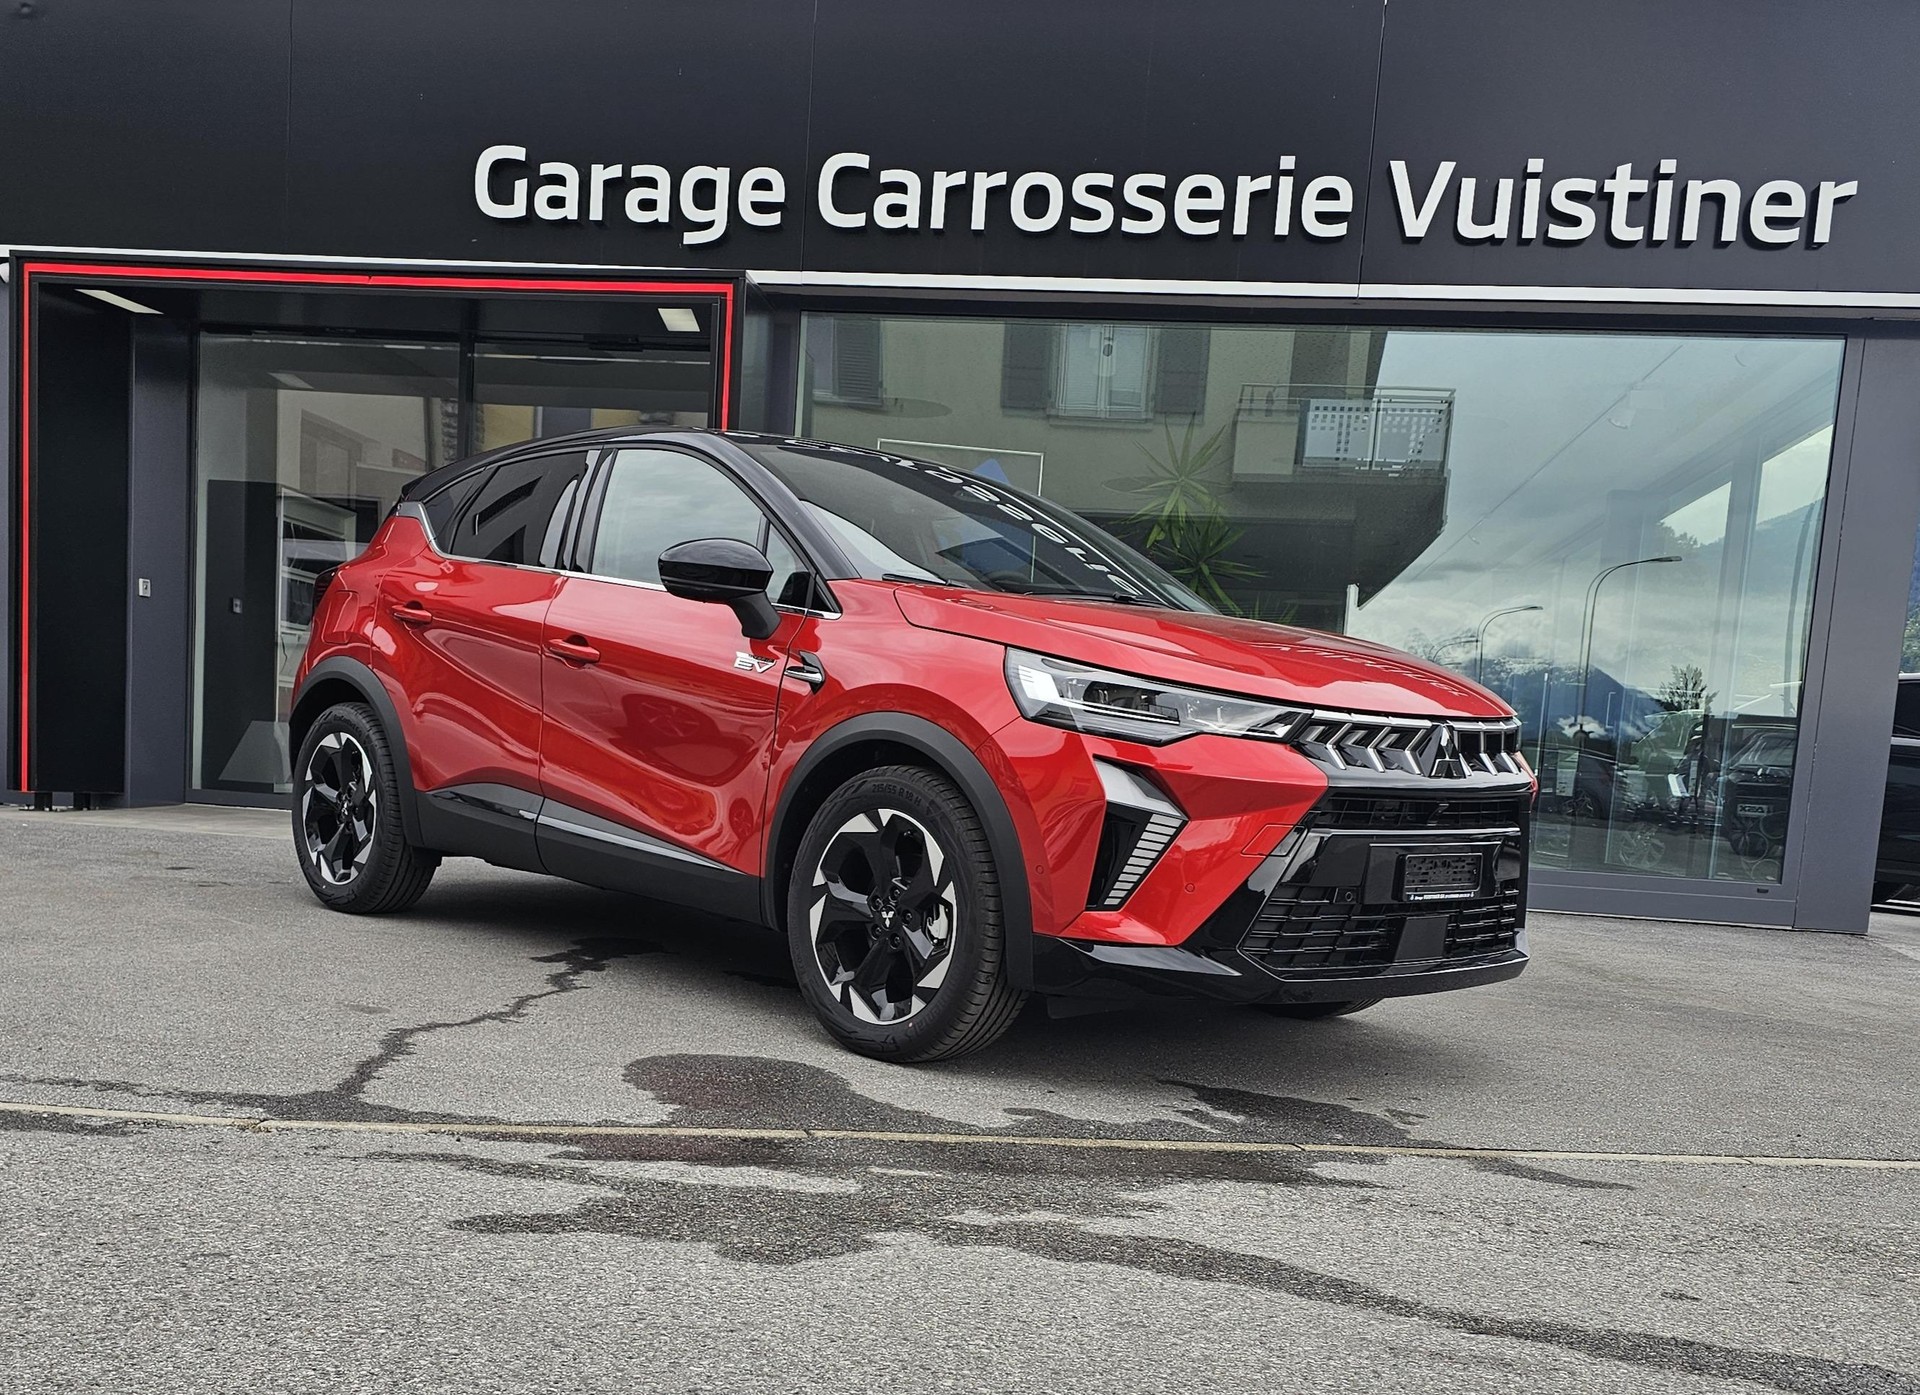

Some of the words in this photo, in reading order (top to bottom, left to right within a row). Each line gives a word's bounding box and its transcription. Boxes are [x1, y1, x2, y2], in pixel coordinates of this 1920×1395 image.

[474, 145, 786, 246] Garage
[817, 152, 1354, 238] Carrosserie
[1389, 158, 1859, 244] Vuistiner
